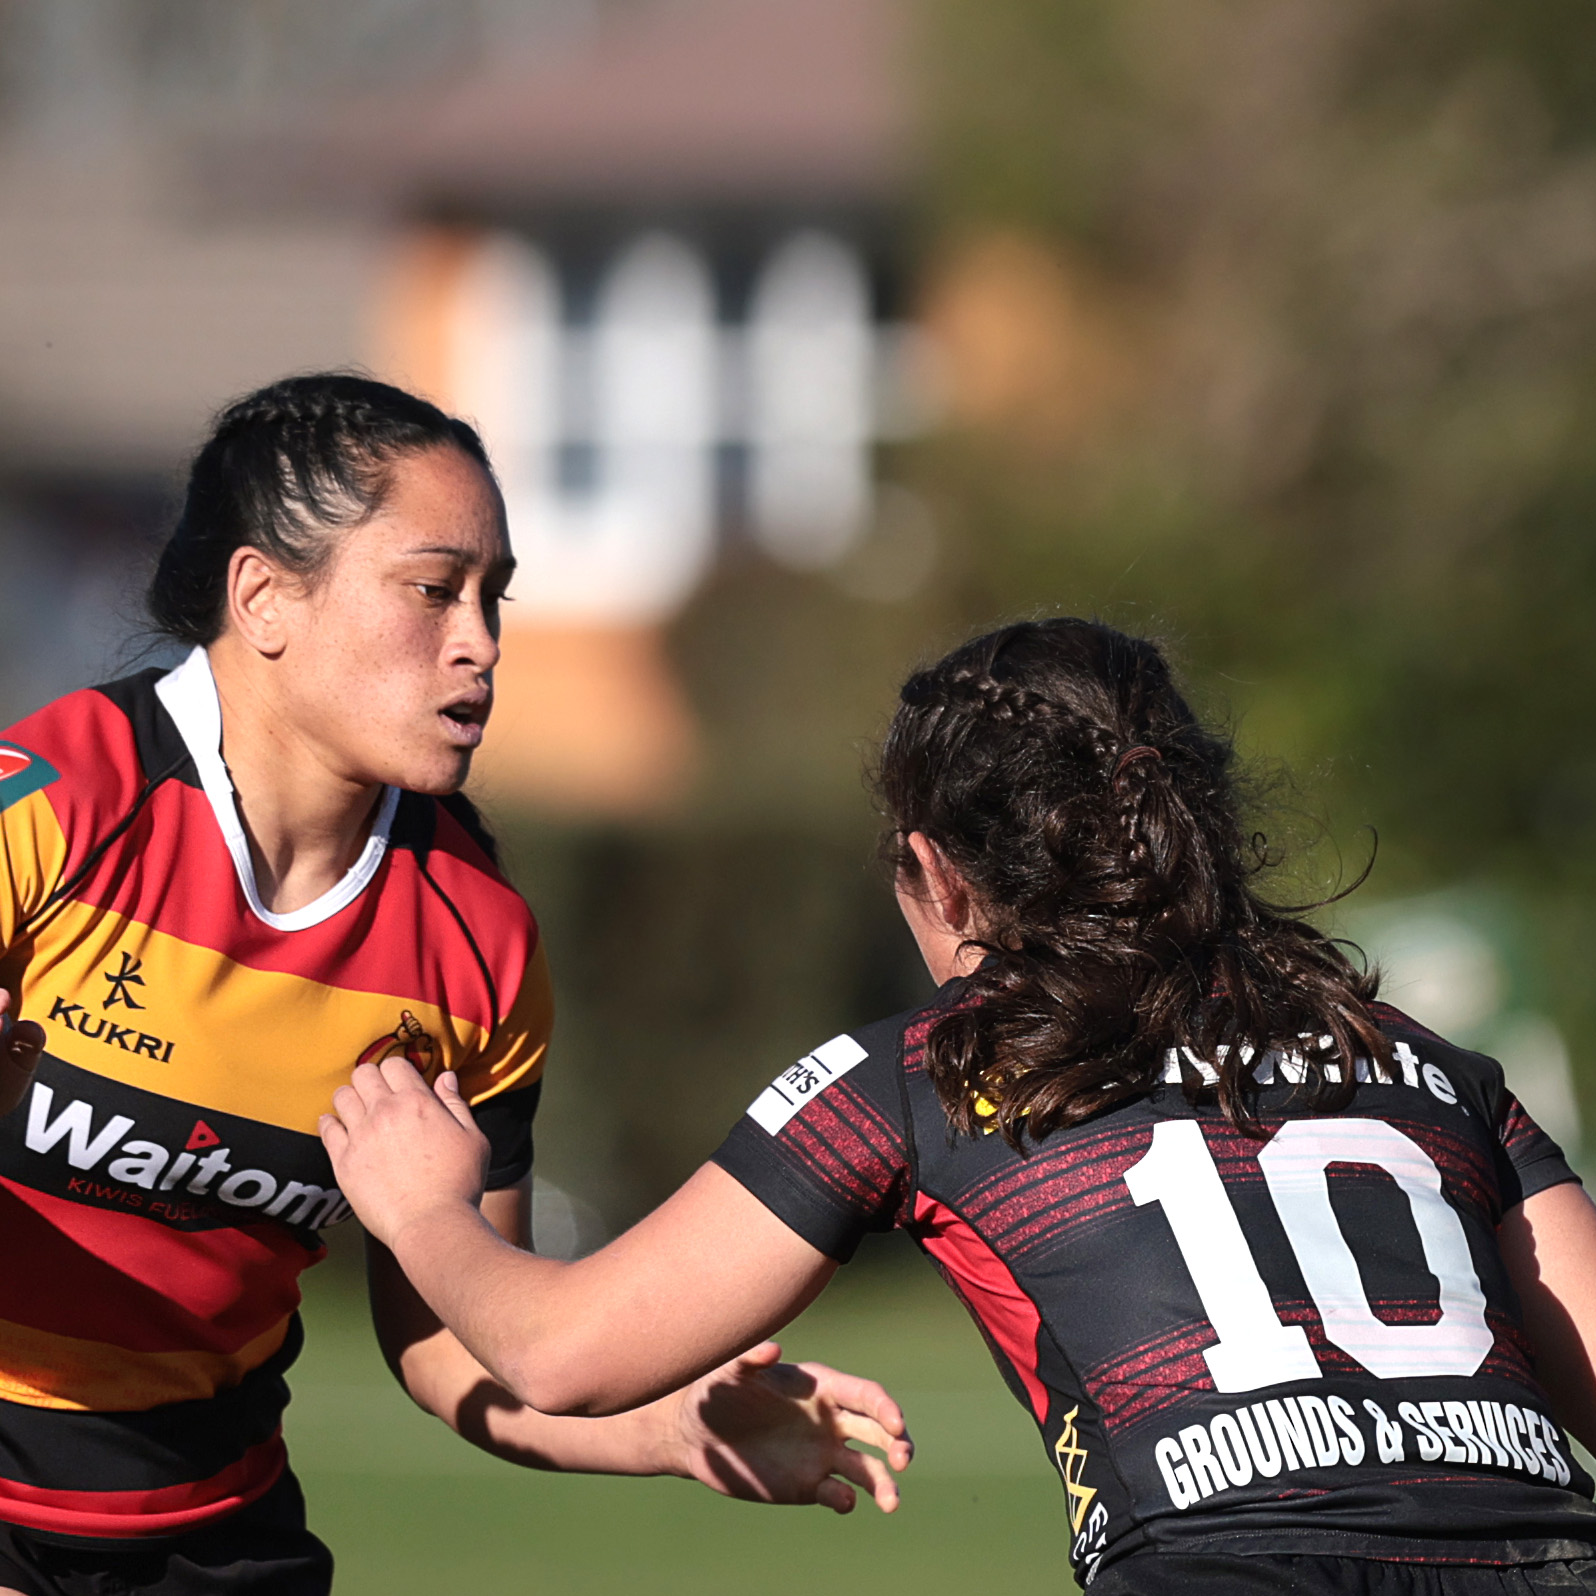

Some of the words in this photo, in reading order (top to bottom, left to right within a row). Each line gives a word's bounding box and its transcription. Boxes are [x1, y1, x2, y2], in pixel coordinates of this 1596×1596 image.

[46, 995, 175, 1064] KUKRI
[68, 1176, 144, 1208] KIWIS
[1122, 1118, 1494, 1394] 10
[1154, 1395, 1361, 1511] GROUNDS
[1375, 1398, 1406, 1464] &
[1416, 1398, 1571, 1486] SERVICES
